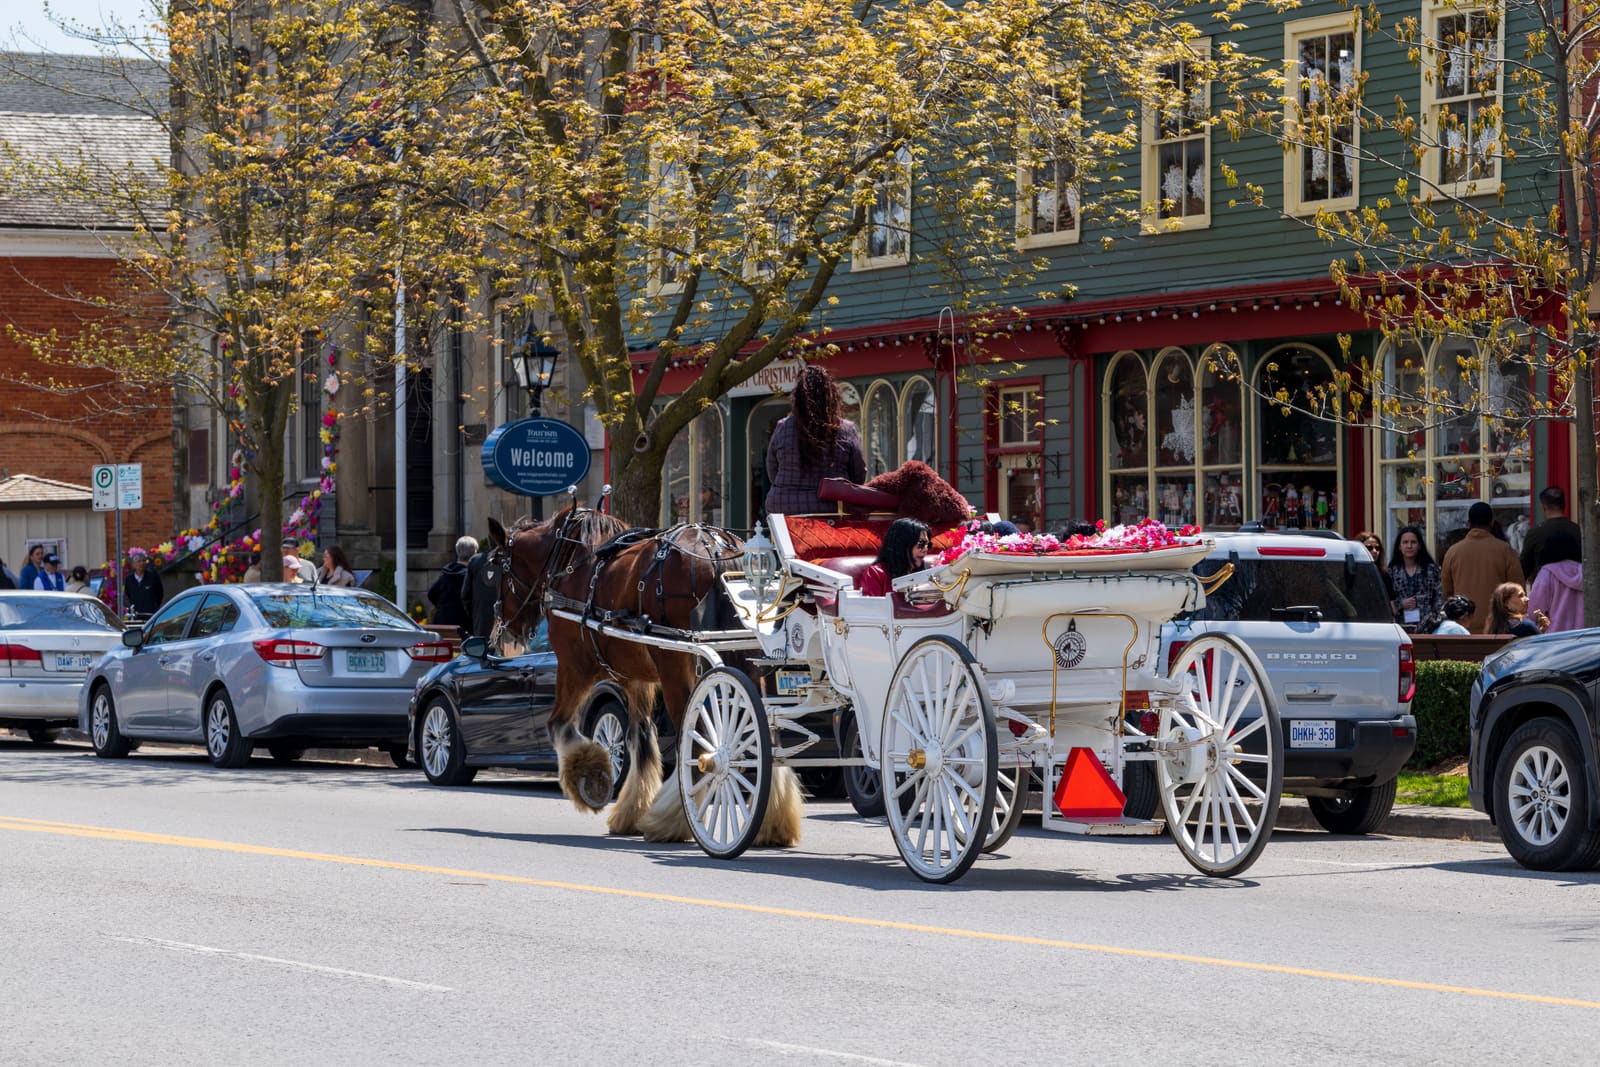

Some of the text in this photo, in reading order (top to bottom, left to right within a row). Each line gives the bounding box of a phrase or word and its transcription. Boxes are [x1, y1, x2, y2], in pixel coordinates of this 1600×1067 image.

[526, 429, 558, 438] Tourism
[510, 447, 574, 468] Welcome
[101, 471, 108, 483] P
[1292, 727, 1335, 741] DHKH 358
